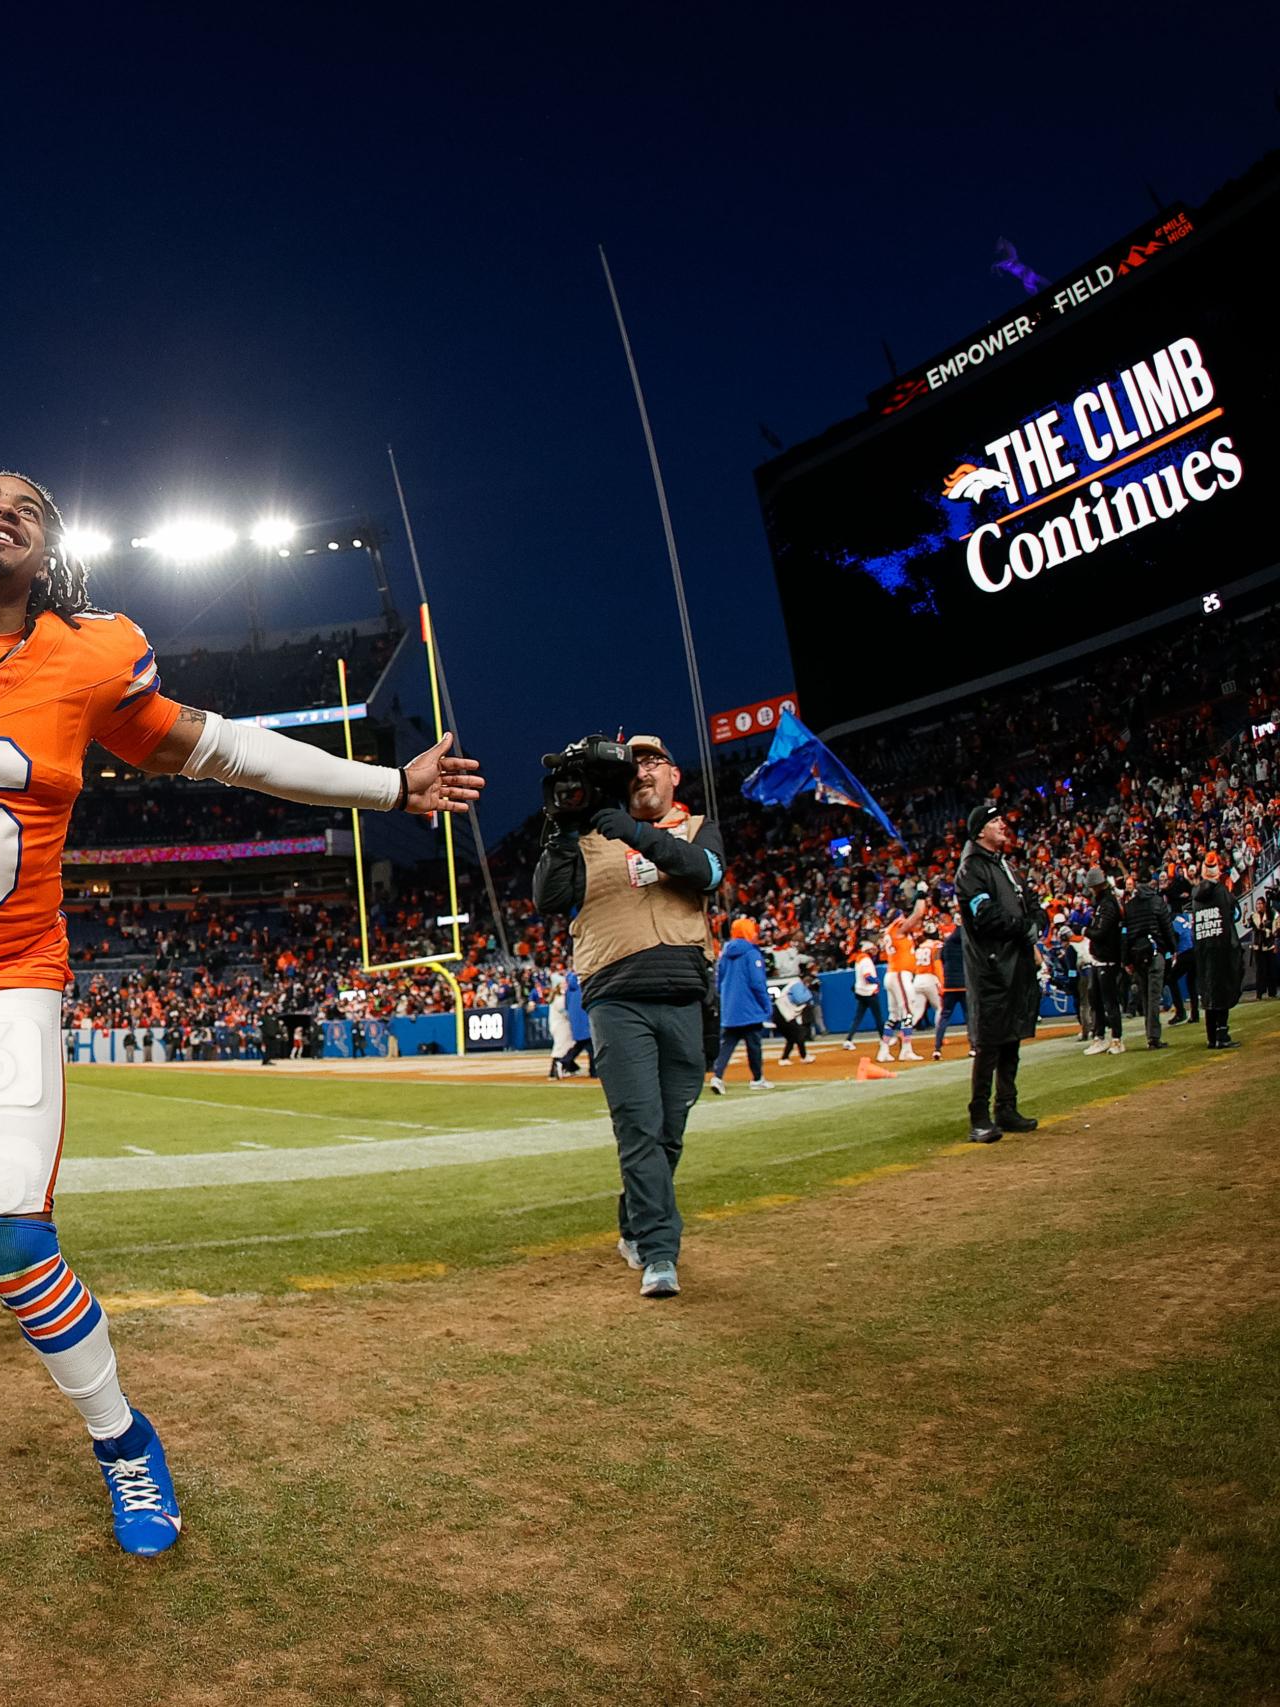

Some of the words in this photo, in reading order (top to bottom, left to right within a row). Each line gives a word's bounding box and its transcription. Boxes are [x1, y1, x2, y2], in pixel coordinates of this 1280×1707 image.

[1163, 213, 1186, 235] MILE
[1168, 222, 1193, 244] HIGH
[926, 315, 1032, 391] EMPOWER
[1054, 265, 1114, 314] FIELD
[984, 410, 1075, 504] THE
[1073, 337, 1215, 462] CLIMB
[966, 436, 1243, 593] Continues
[1202, 593, 1220, 613] 25
[1195, 919, 1222, 931] EVENT
[1196, 928, 1223, 940] STAFF
